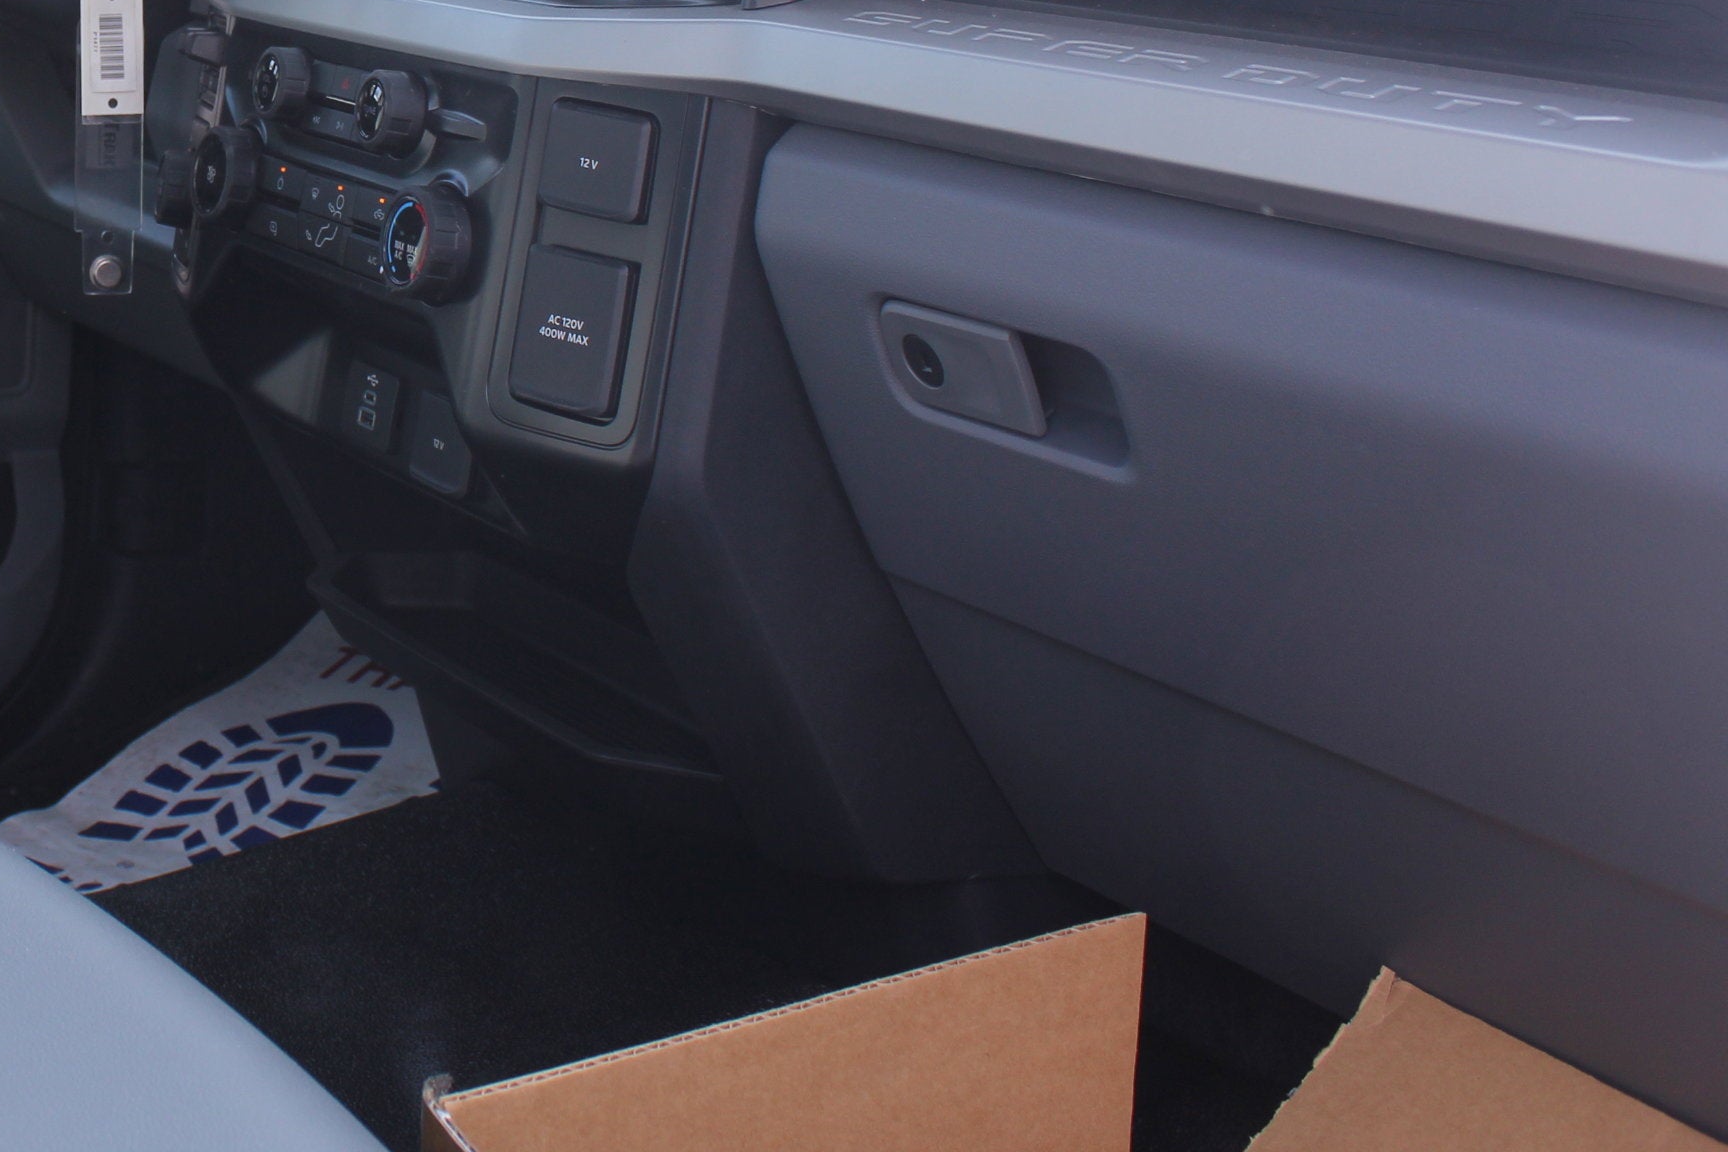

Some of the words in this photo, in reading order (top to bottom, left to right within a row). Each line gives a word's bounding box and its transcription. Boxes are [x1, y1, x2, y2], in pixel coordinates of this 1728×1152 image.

[843, 10, 1208, 72] SUPER
[1222, 63, 1635, 129] DUTY
[548, 314, 561, 326] AC
[562, 317, 584, 330] 120V
[539, 326, 566, 341] 400W
[567, 332, 589, 346] MAX
